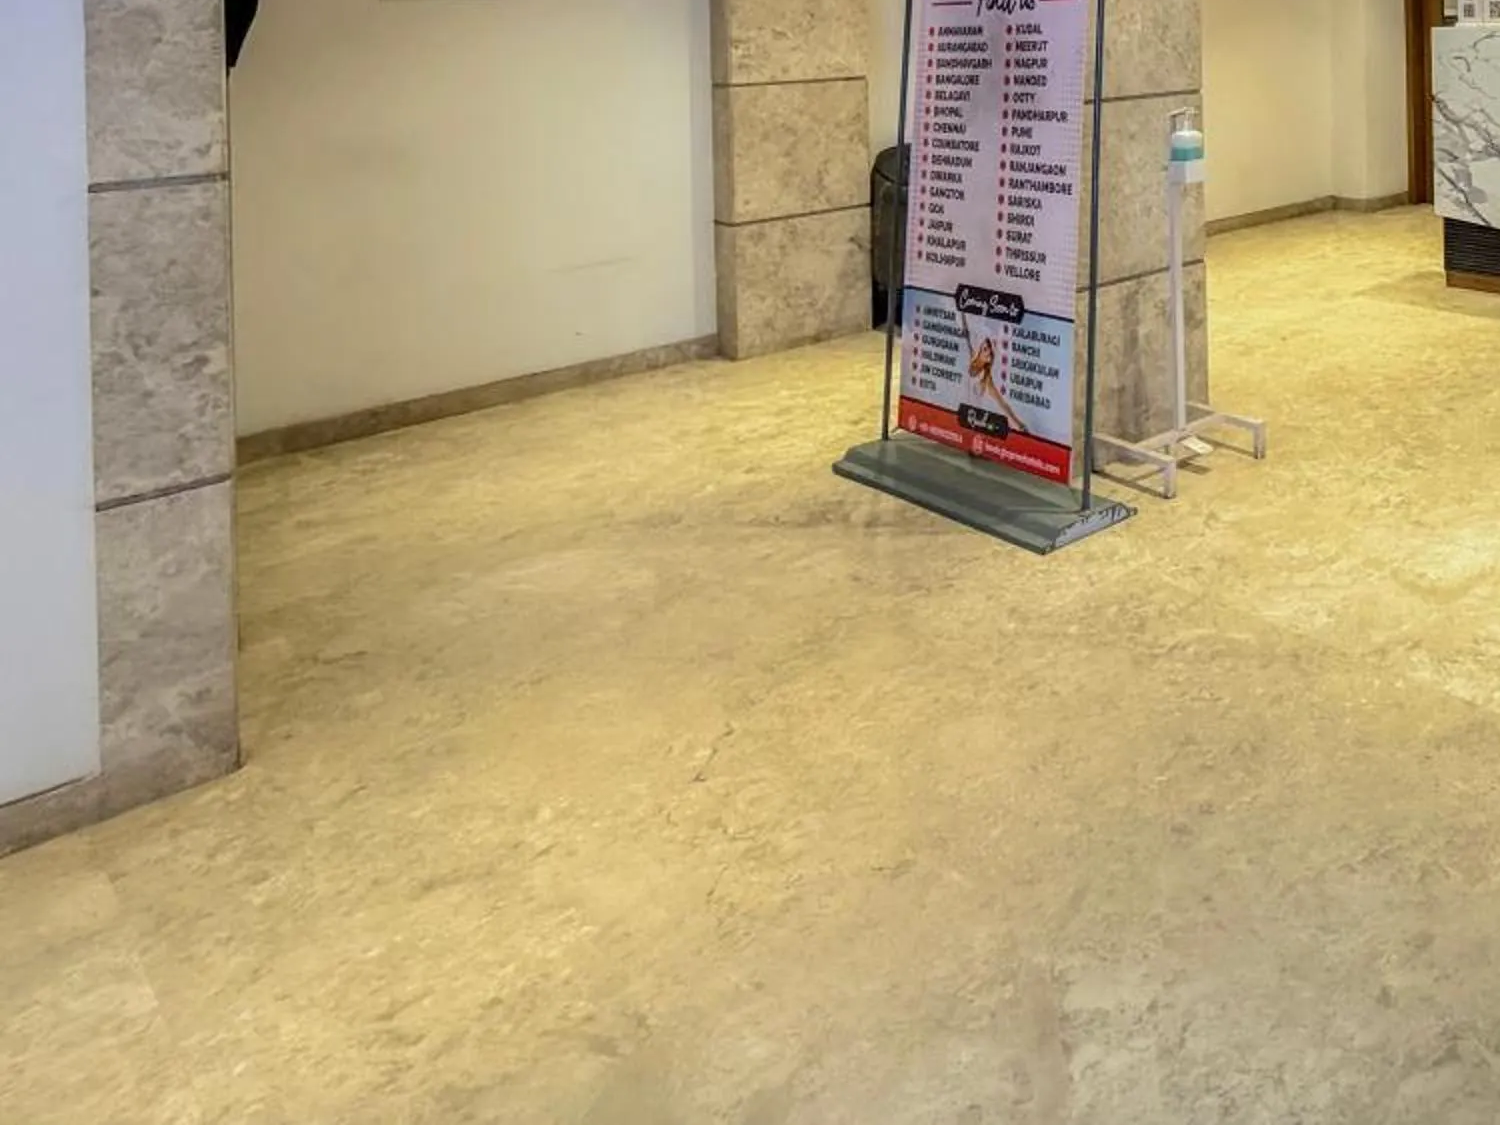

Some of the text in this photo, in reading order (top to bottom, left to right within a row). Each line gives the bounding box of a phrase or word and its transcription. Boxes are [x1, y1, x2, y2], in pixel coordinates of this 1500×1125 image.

[1014, 57, 1049, 70] NAGPUR
[935, 74, 980, 86] BANGALORE
[1007, 177, 1074, 196] RANTHAMBORE
[1005, 229, 1034, 245] SURAT
[1004, 246, 1047, 265] THRISSUR
[1004, 264, 1041, 282] VELLORE
